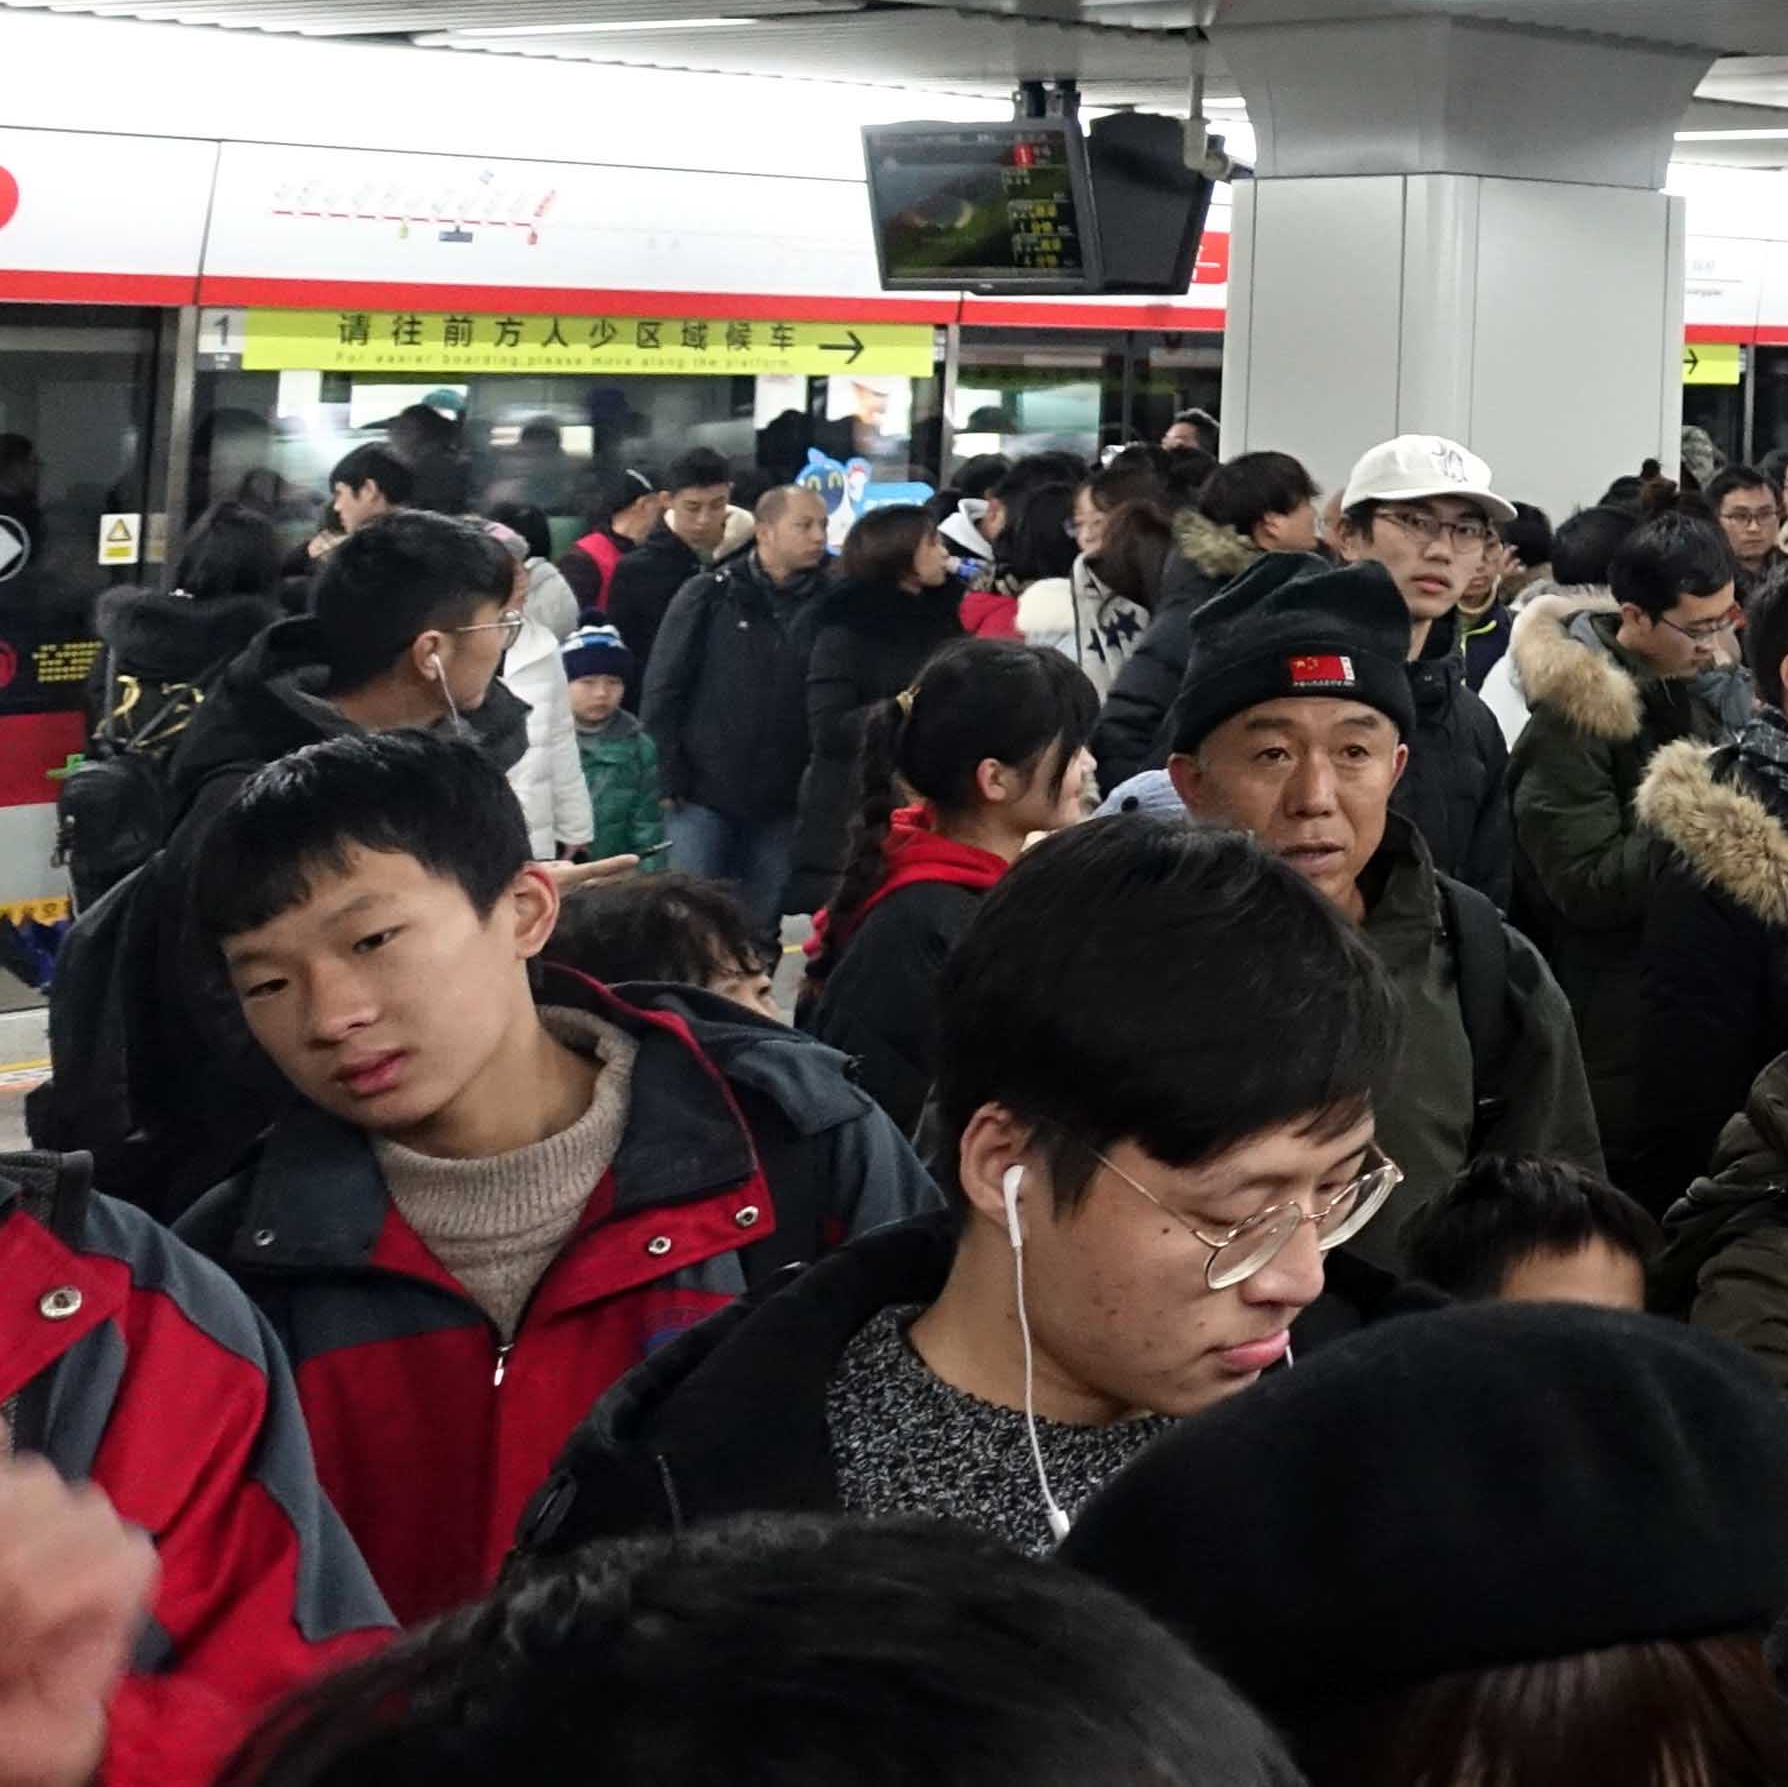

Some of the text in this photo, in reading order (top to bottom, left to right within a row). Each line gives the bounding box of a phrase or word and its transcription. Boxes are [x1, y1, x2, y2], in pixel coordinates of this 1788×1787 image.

[213, 314, 229, 346] 1
[337, 313, 797, 351] 请往前方人少区域候车
